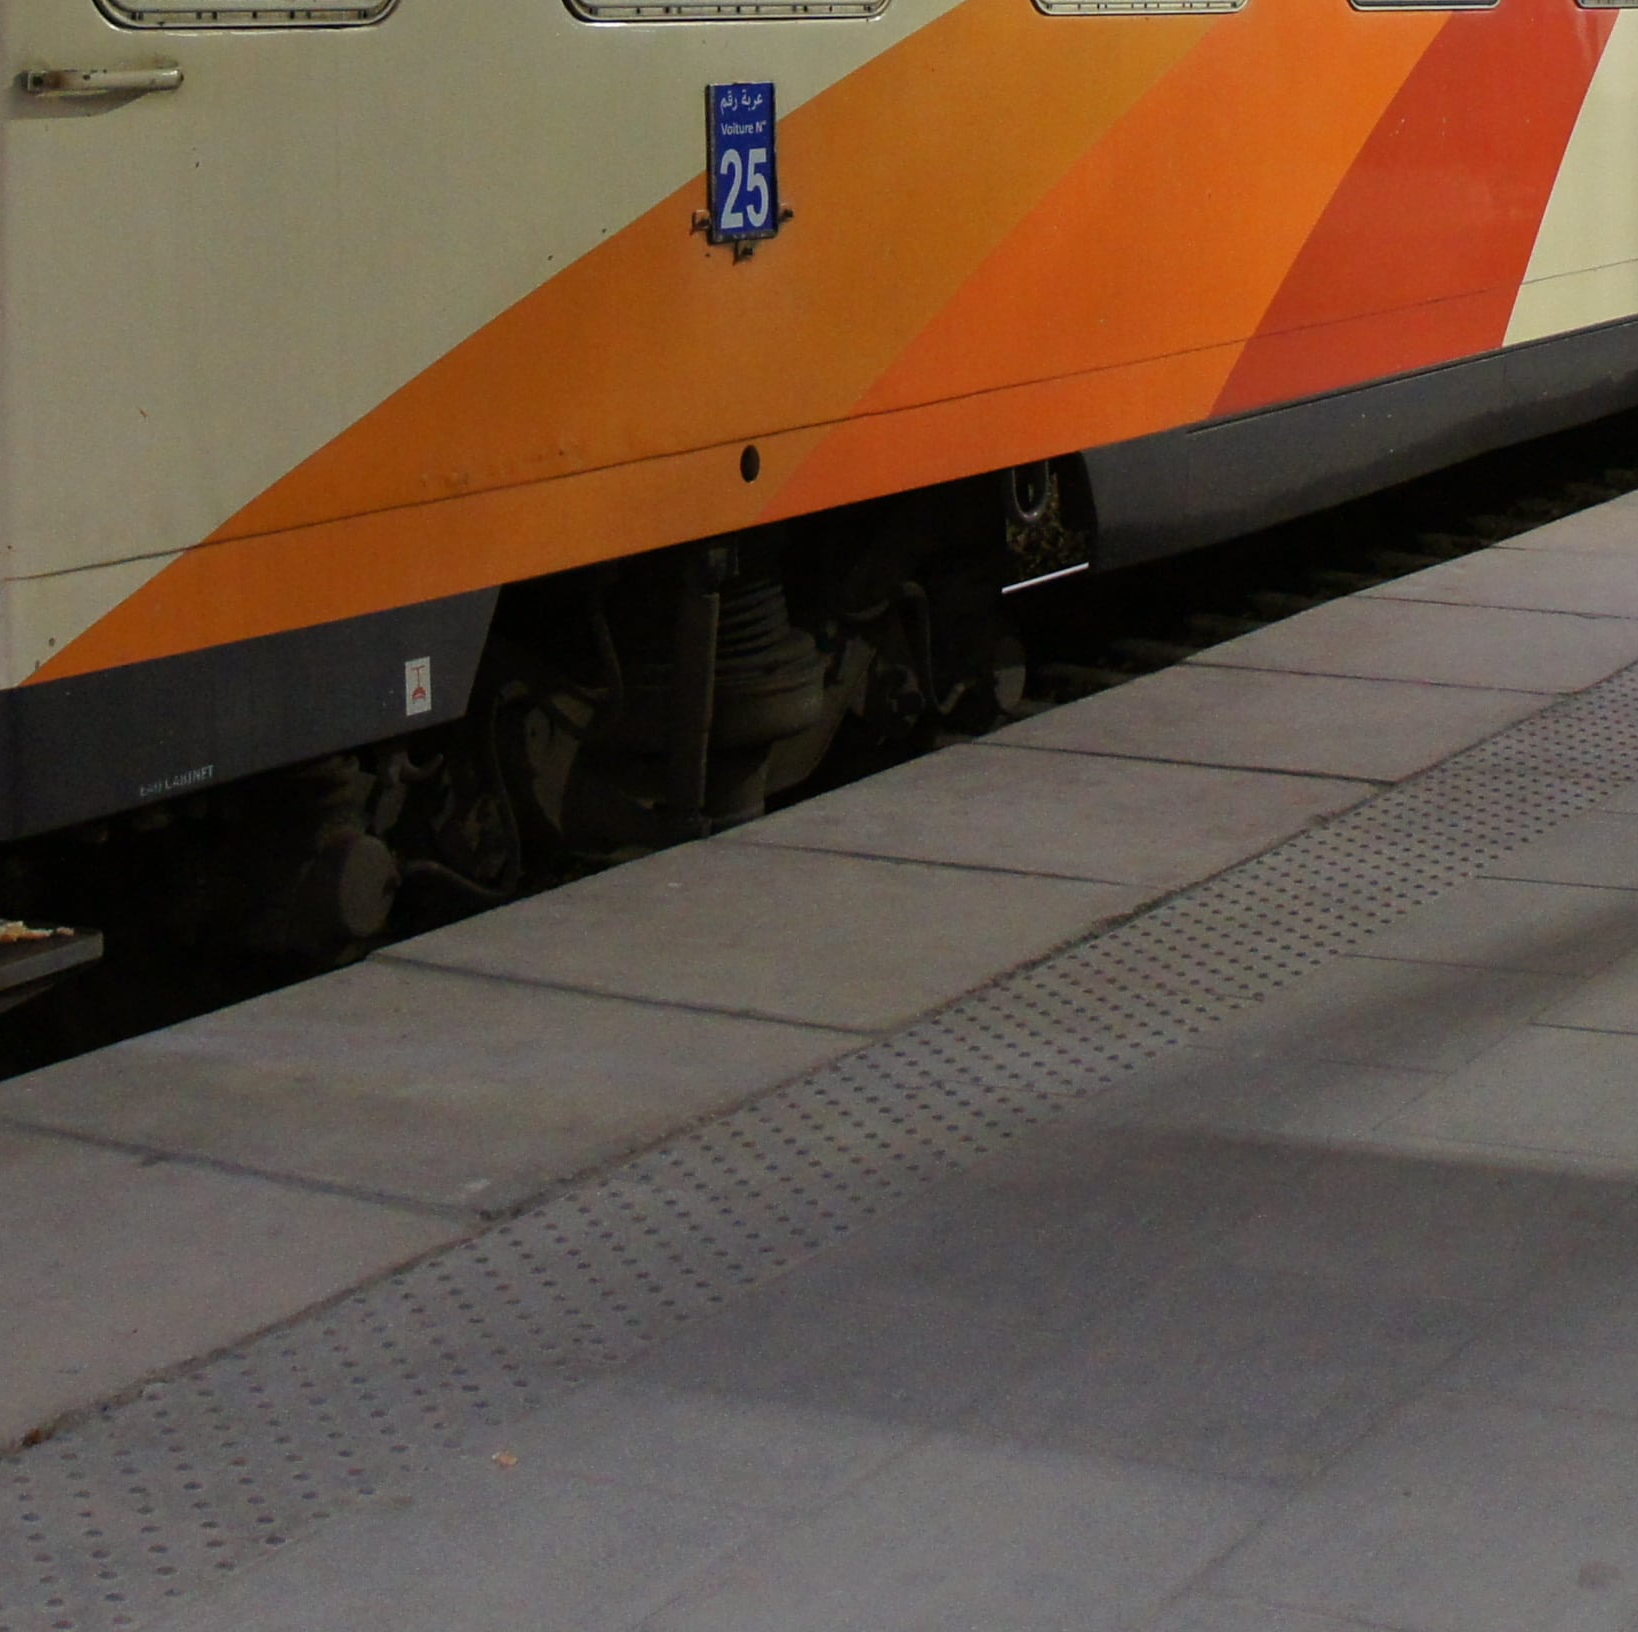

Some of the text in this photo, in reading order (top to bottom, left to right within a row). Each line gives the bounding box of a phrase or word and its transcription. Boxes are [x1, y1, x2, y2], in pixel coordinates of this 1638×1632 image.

[720, 89, 763, 115] عربة رقم
[721, 122, 754, 135] Voiture
[720, 148, 769, 229] 25
